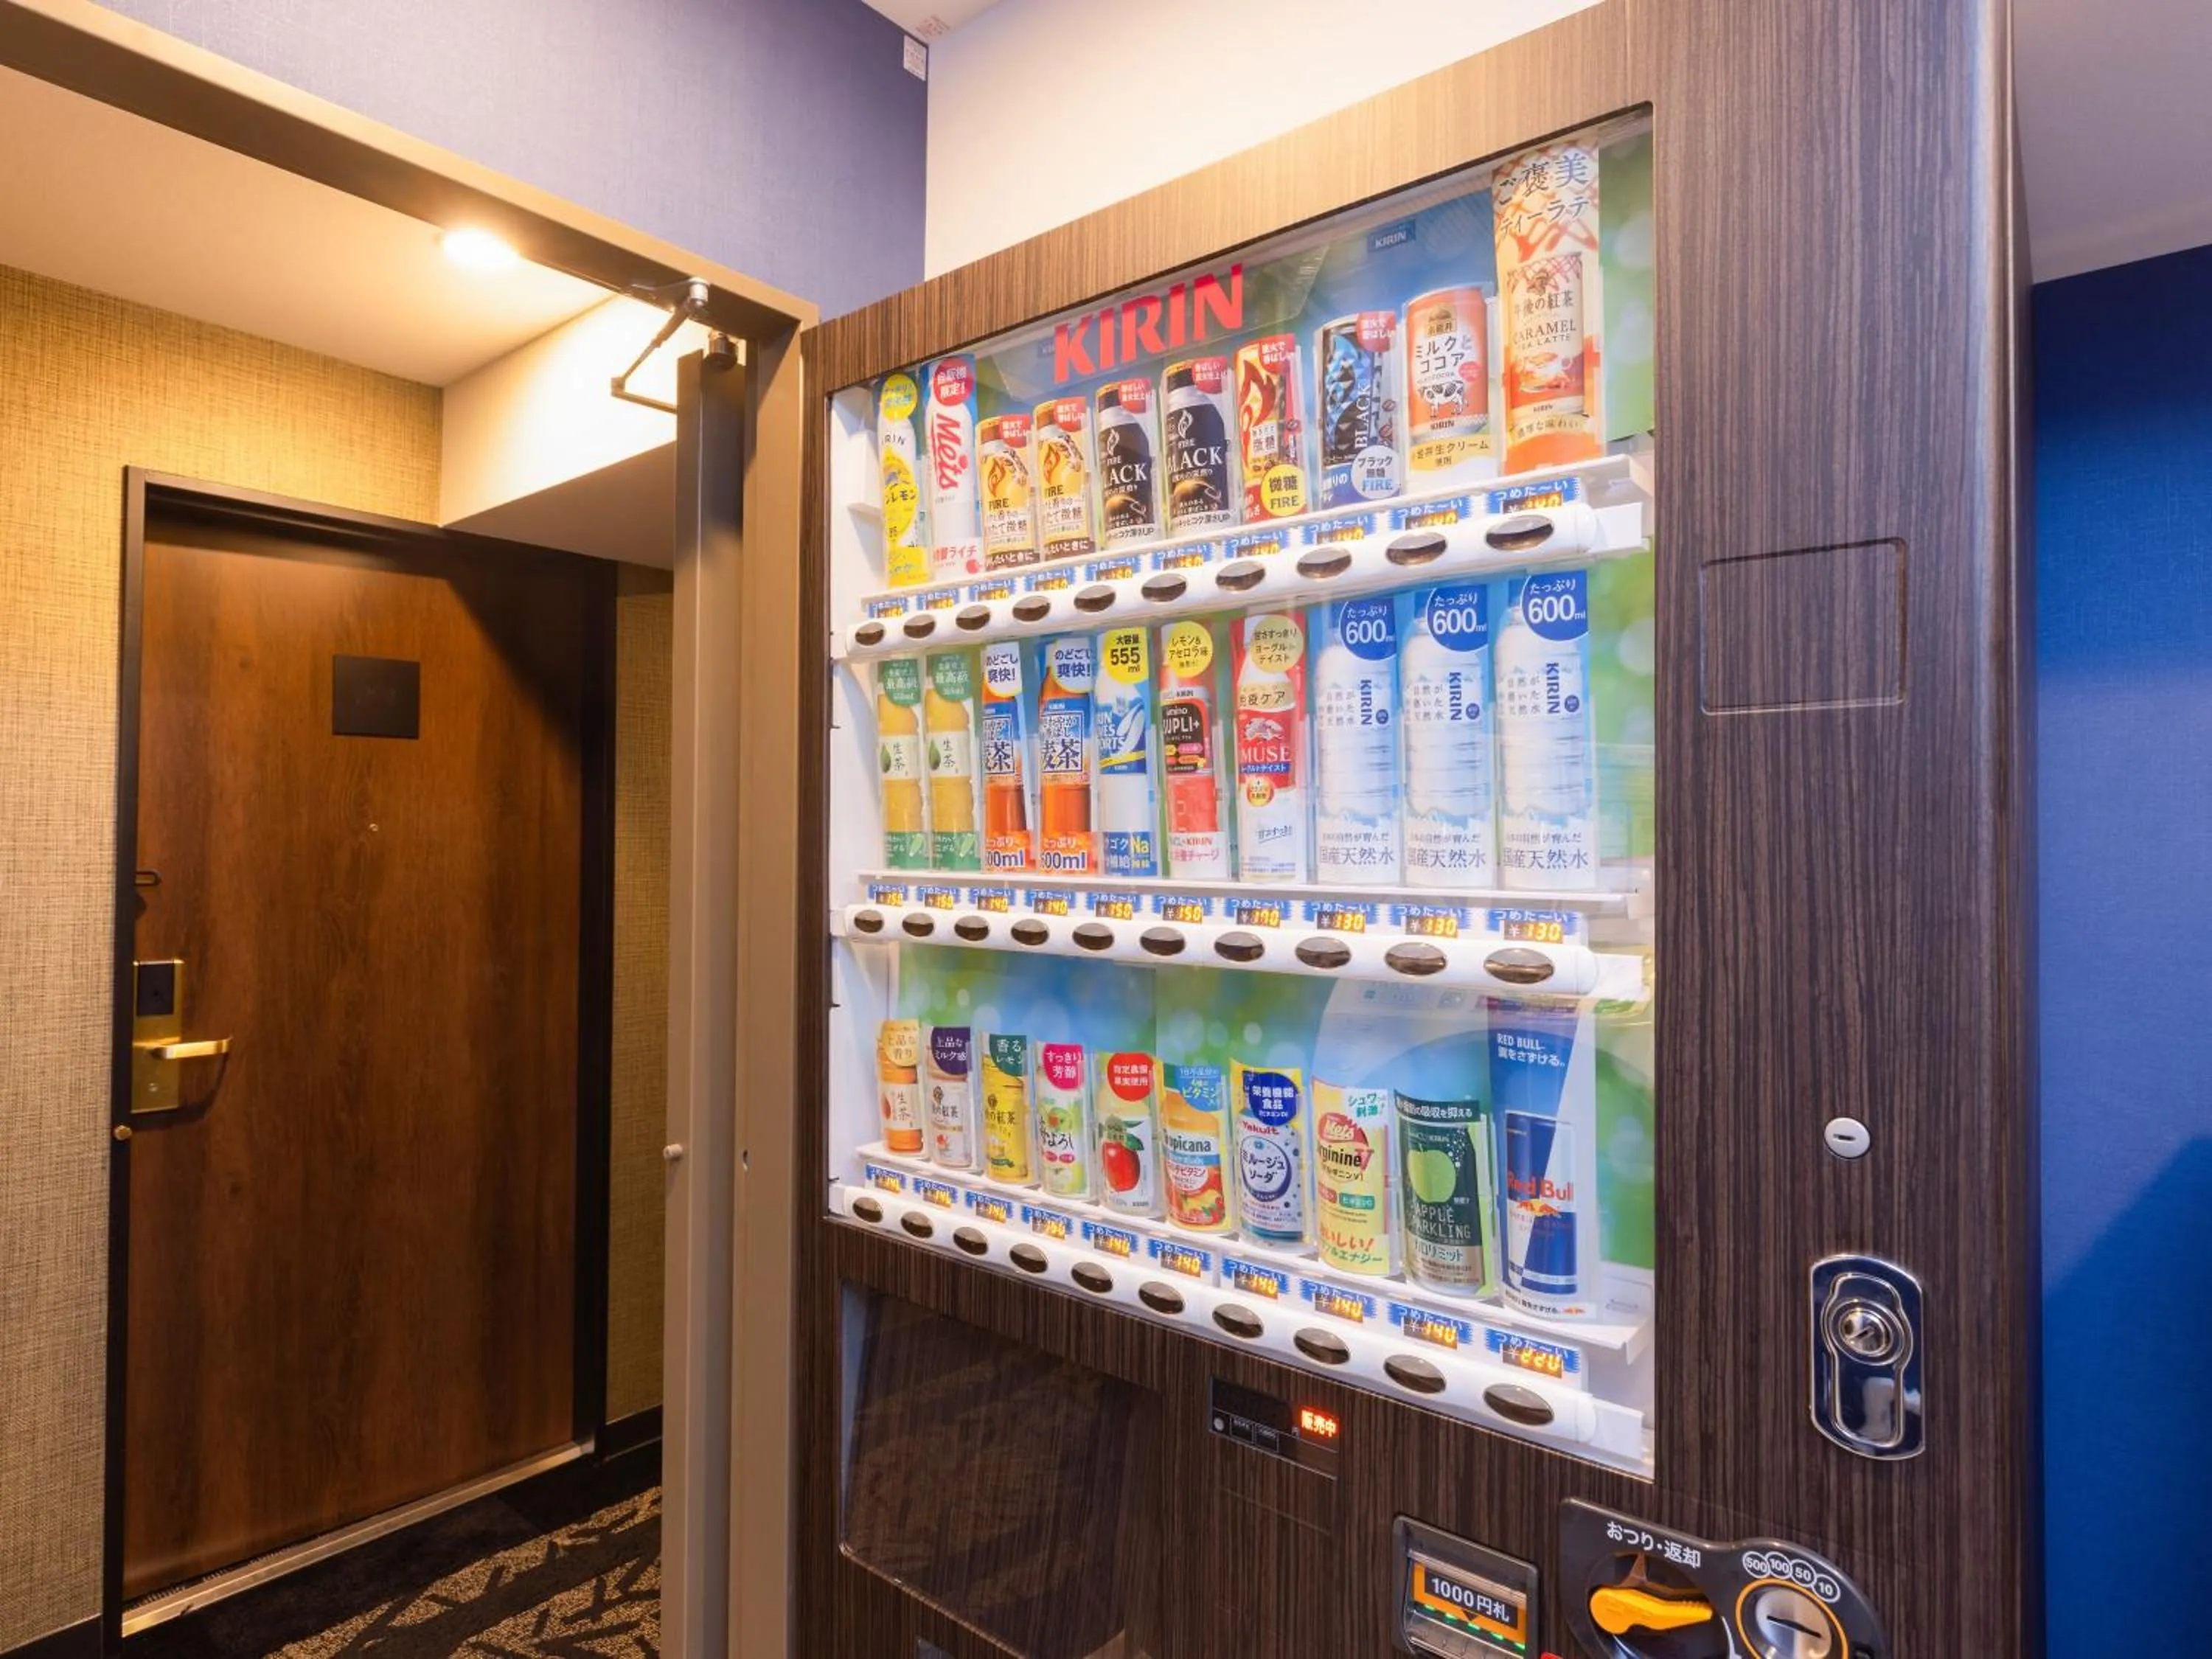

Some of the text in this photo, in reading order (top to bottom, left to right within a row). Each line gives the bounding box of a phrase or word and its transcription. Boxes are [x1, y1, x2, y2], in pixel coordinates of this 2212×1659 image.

[1499, 153, 1589, 206] ご褒美
[1500, 196, 1590, 240] ティーラテ
[1054, 263, 1243, 384] KIRIN
[1512, 318, 1577, 345] CARAMEL
[1416, 335, 1472, 358] ミルクと
[1419, 352, 1466, 375] ココア
[1354, 383, 1371, 449] BLACK
[935, 413, 968, 490] Mets
[1357, 455, 1394, 467] ブラック
[1107, 462, 1148, 488] ACK
[1268, 475, 1298, 493] 微糖
[1361, 478, 1394, 493] FIRE
[989, 498, 1009, 510] FIRE
[1270, 495, 1299, 510] FIRE
[1528, 580, 1576, 595] たっぷり
[1433, 593, 1478, 608] たっぷり
[1527, 597, 1576, 623] 600
[1346, 607, 1388, 619] たっぷり
[1433, 609, 1476, 635] 600
[1116, 633, 1141, 645] 大容量
[1345, 620, 1386, 645] 600
[1109, 647, 1141, 667] 555
[987, 667, 1016, 684] 爽快!
[1056, 662, 1091, 678] 爽快!
[1449, 671, 1463, 721] KIRIN
[1546, 662, 1560, 714] KIRIN
[1360, 678, 1373, 726] KIRIN
[1131, 835, 1150, 854] Na
[1320, 846, 1396, 866] 国産天然水
[1408, 846, 1487, 869] 国産天然水
[1503, 847, 1589, 869] 国産天然水
[996, 1039, 1022, 1054] 香る
[1496, 1032, 1514, 1046] RED
[1262, 1098, 1284, 1110] 食品
[1249, 1169, 1279, 1183] ソーダ
[1540, 1180, 1575, 1203] Bull
[1413, 1215, 1472, 1239] ARKLING
[1301, 1409, 1338, 1437] 販売中
[1607, 1521, 1702, 1568] おつり・返却
[1745, 1557, 1767, 1573] 500
[1769, 1557, 1790, 1576] 100
[1794, 1566, 1813, 1583] 50
[1431, 1577, 1510, 1623] 1000円札
[1818, 1582, 1834, 1597] 10
